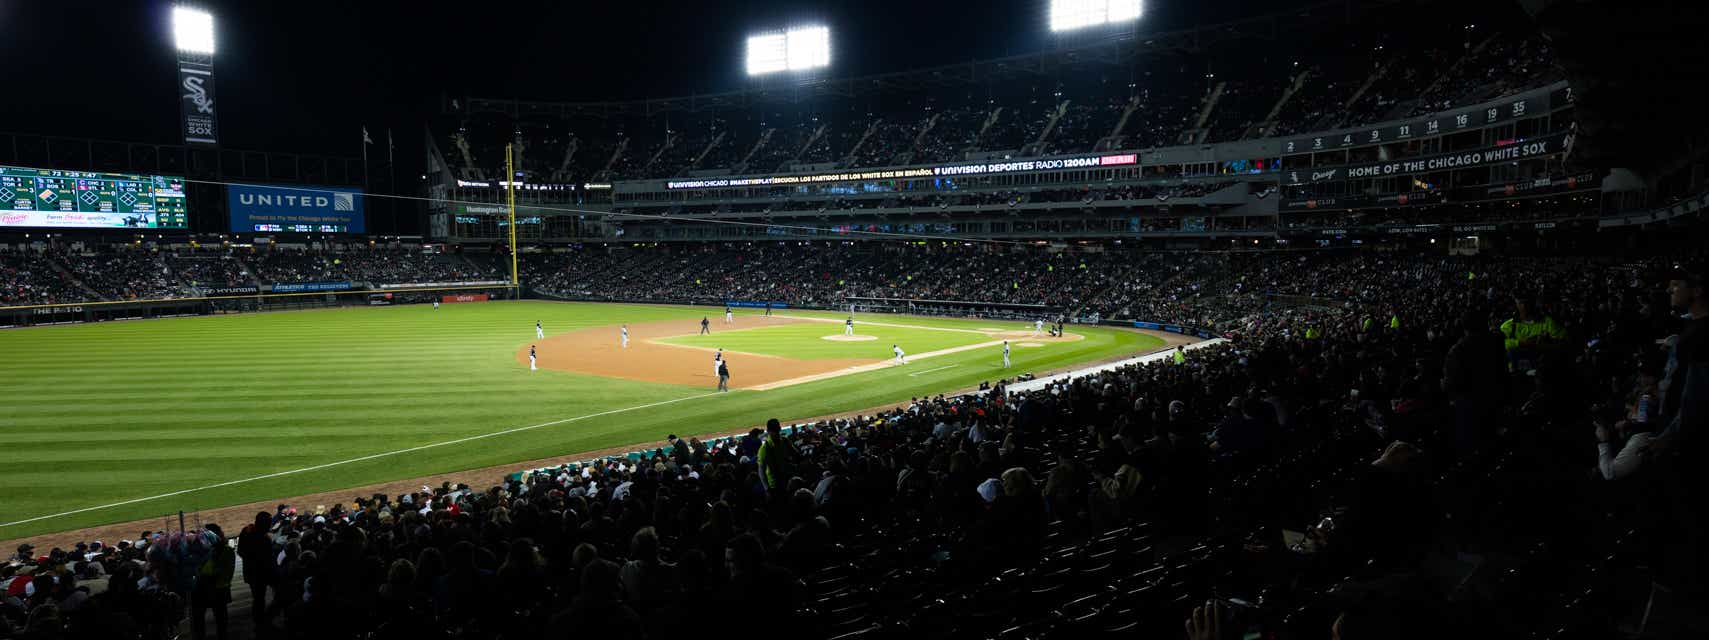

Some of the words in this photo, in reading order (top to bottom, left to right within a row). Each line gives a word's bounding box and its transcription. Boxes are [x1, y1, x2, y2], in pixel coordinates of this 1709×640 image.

[1513, 101, 1525, 113] 35
[1487, 108, 1497, 119] 19
[1456, 115, 1468, 125] 16
[188, 126, 212, 135] SOX
[1400, 126, 1409, 135] 11
[1428, 120, 1438, 131] 14
[1344, 135, 1351, 143] 4
[1372, 130, 1379, 139] 9
[1315, 138, 1321, 146] 3
[1348, 166, 1380, 177] HOME
[1384, 164, 1400, 174] OF
[1403, 160, 1425, 172] THE
[1428, 153, 1481, 169] CHICAGO
[1484, 146, 1519, 162] WHITE
[1522, 142, 1546, 156] SOX
[941, 165, 986, 175] UNIVISION
[988, 162, 1033, 172] DEPORTES
[1035, 160, 1063, 169] RADIO
[1064, 157, 1099, 167] 1200AM
[904, 168, 933, 176] ESPAÑOL
[240, 193, 329, 207] UNITED
